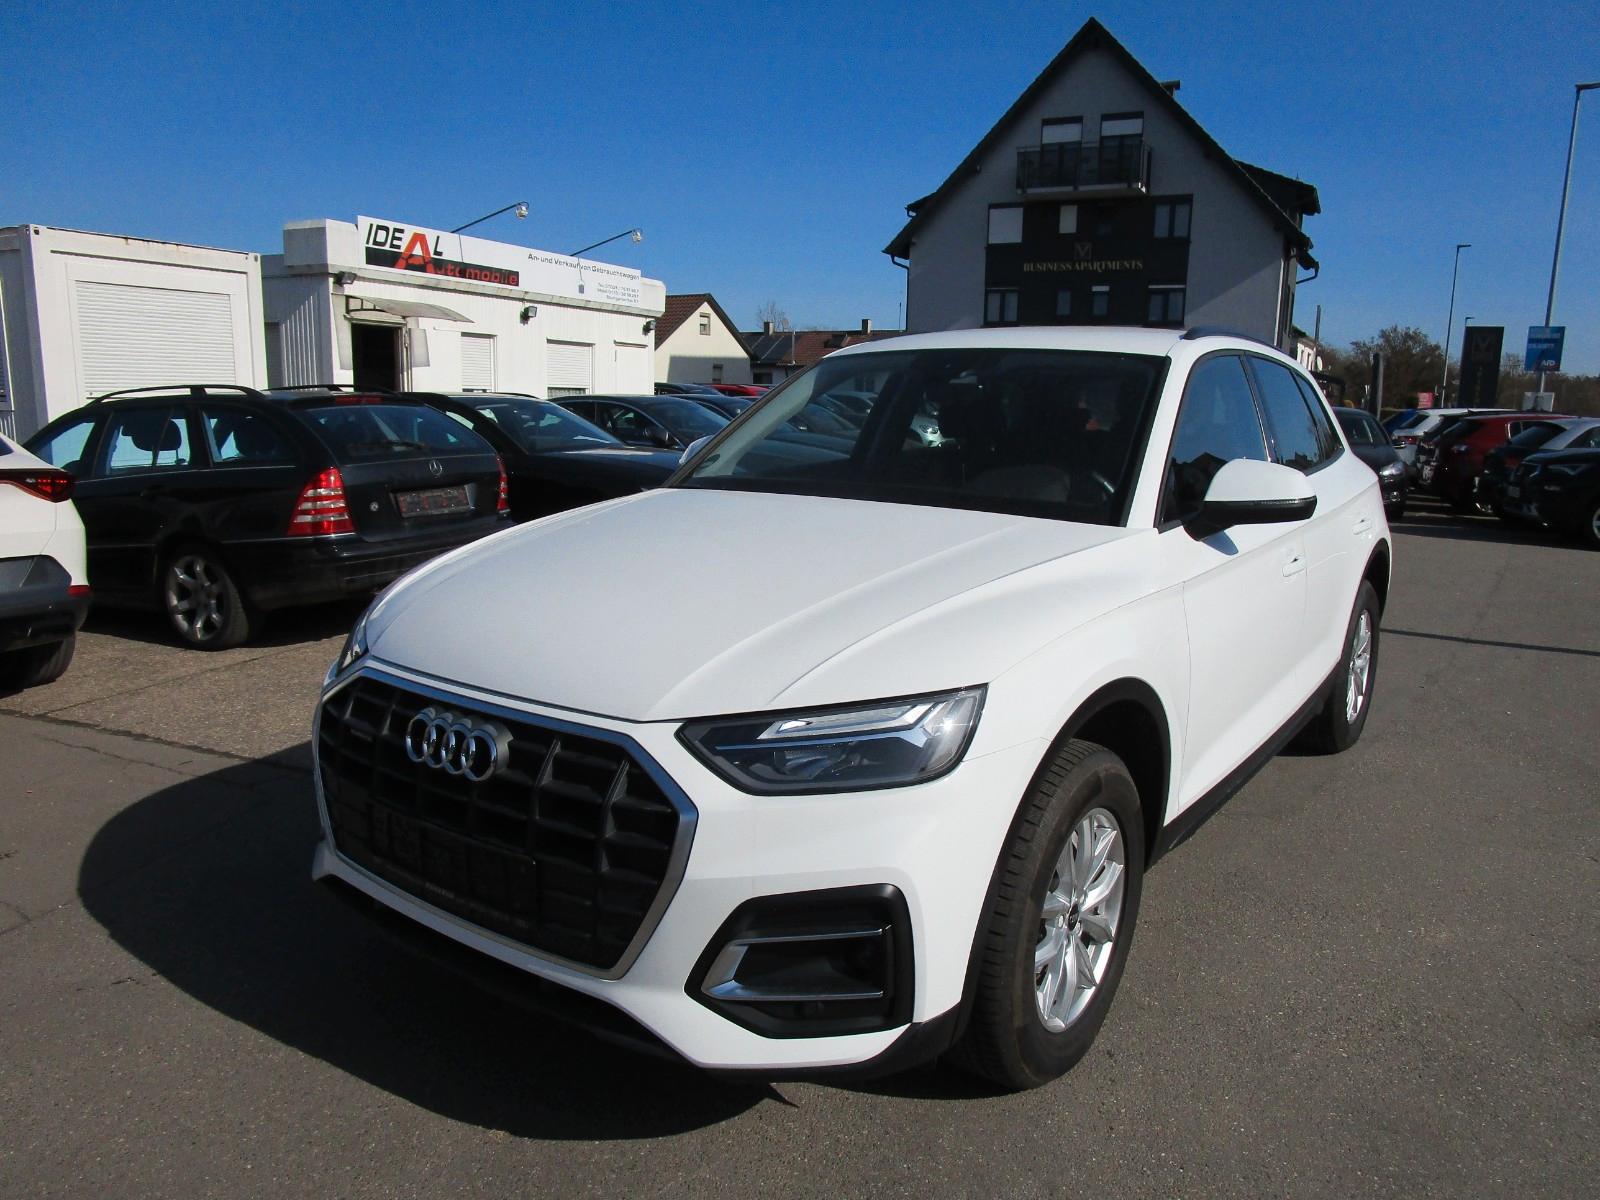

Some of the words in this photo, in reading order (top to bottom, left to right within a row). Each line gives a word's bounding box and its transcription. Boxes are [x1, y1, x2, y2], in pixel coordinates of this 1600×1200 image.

[366, 223, 443, 272] IDEAL
[540, 256, 553, 264] und
[553, 258, 580, 269] Verkauf
[591, 265, 640, 280] Gebrauchtwagen
[1023, 262, 1072, 272] BUSINESS
[1072, 260, 1143, 272] APARTMENTS
